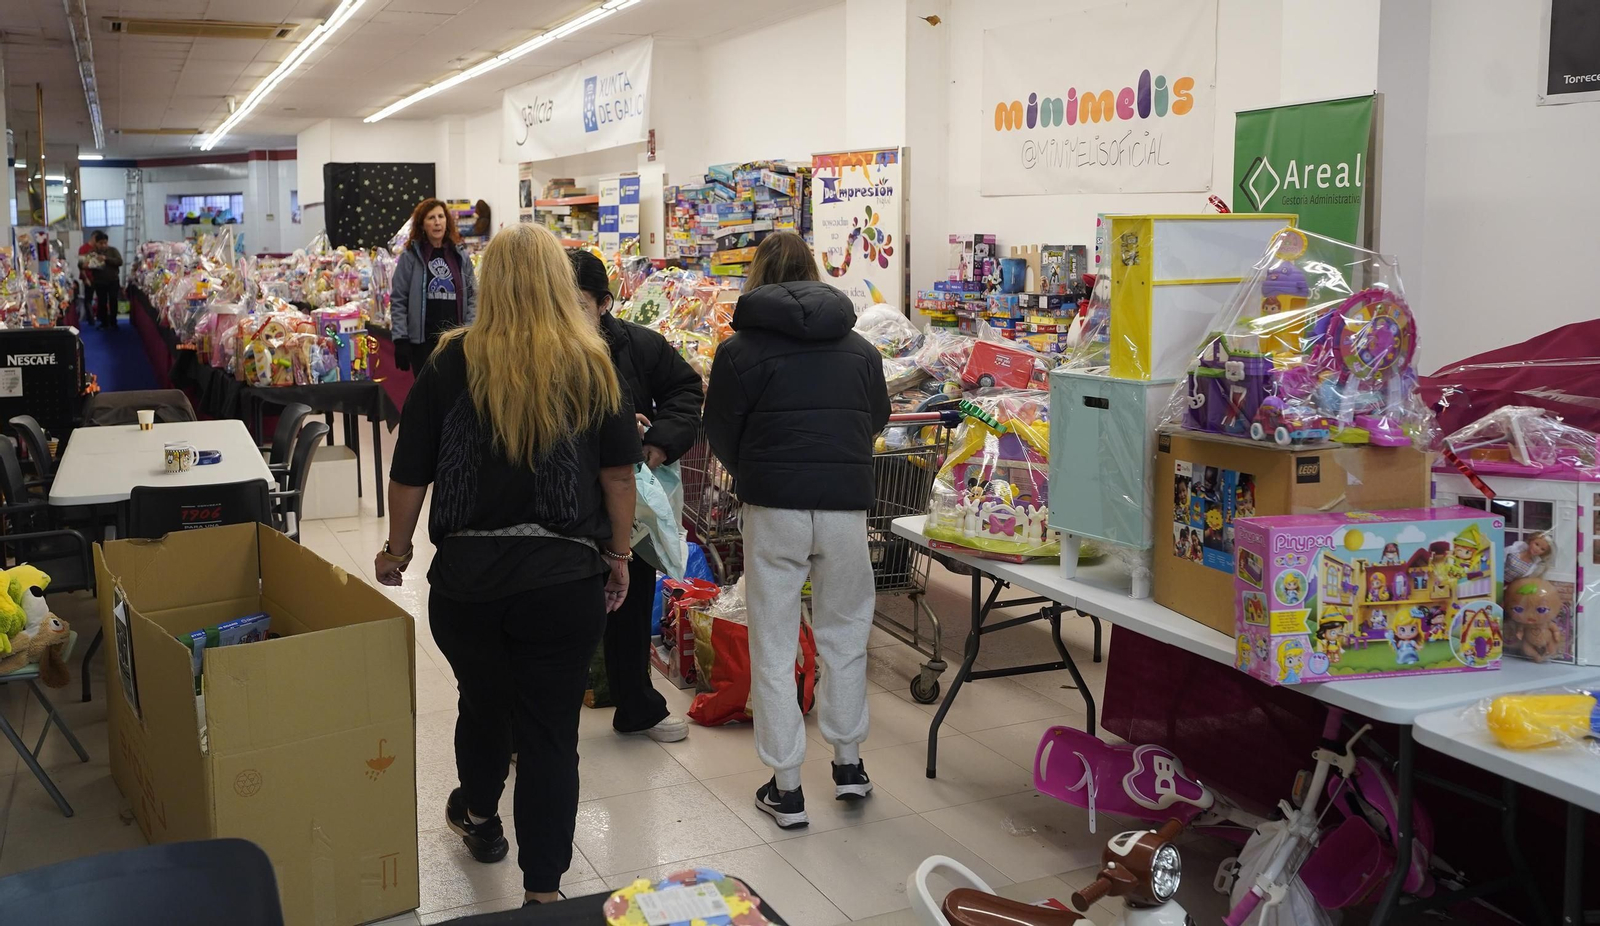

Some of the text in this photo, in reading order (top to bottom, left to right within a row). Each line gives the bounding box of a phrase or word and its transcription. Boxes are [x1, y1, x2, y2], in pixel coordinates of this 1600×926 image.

[599, 71, 632, 97] XUNTA
[994, 69, 1195, 132] minimelis
[516, 96, 554, 146] galicia
[598, 104, 613, 124] DE
[1283, 153, 1362, 190] Areal
[1309, 194, 1361, 205] Administrativa
[7, 353, 56, 366] NESCAFÉ
[1298, 463, 1319, 476] LEGO
[181, 507, 222, 522] 1906
[1274, 533, 1336, 553] Pinypon
